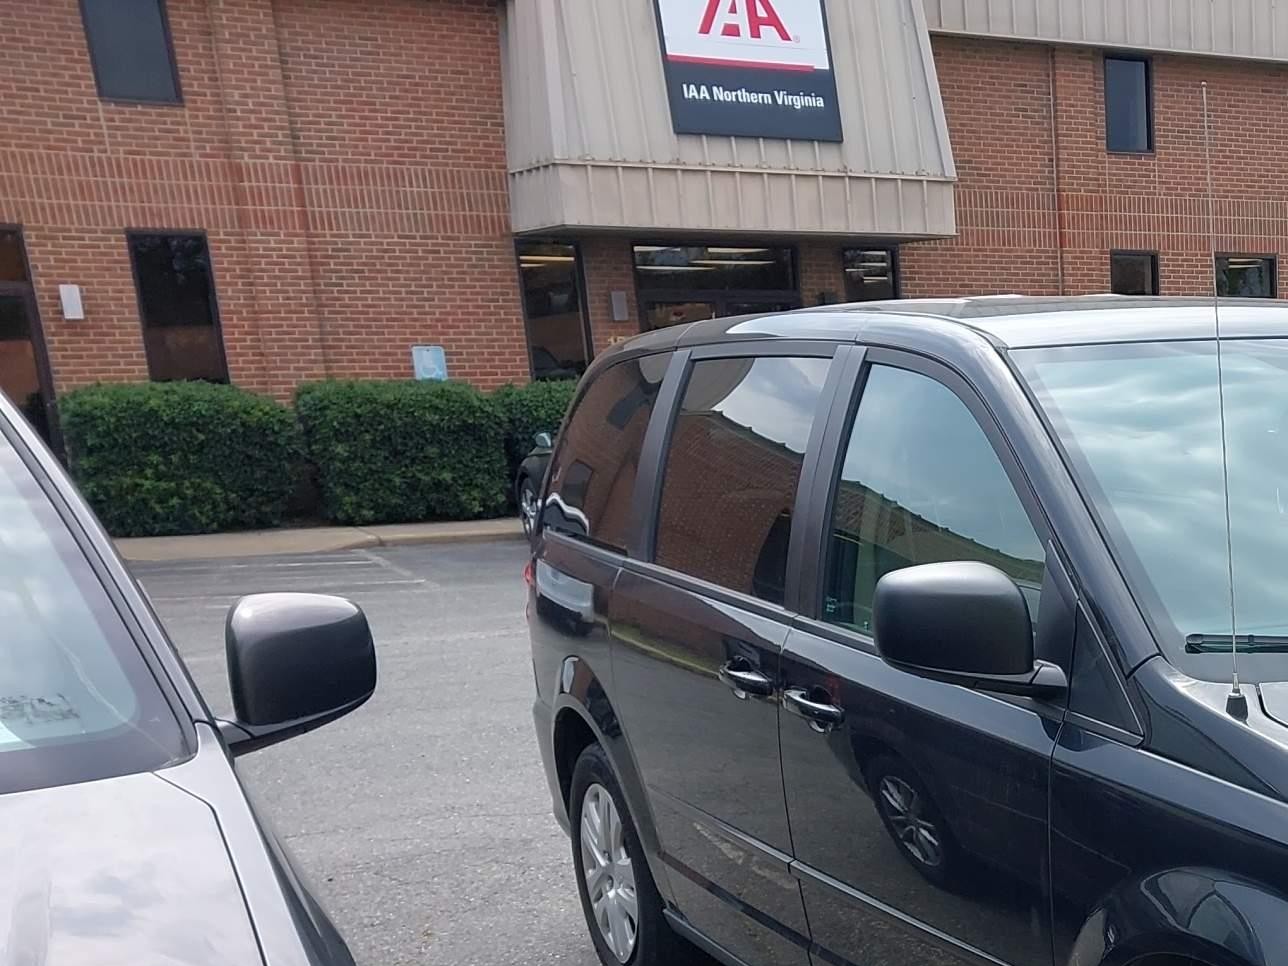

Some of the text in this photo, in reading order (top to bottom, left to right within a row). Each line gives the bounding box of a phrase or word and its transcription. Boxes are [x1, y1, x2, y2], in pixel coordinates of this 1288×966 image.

[683, 84, 825, 110] IAA Northern Virginia
